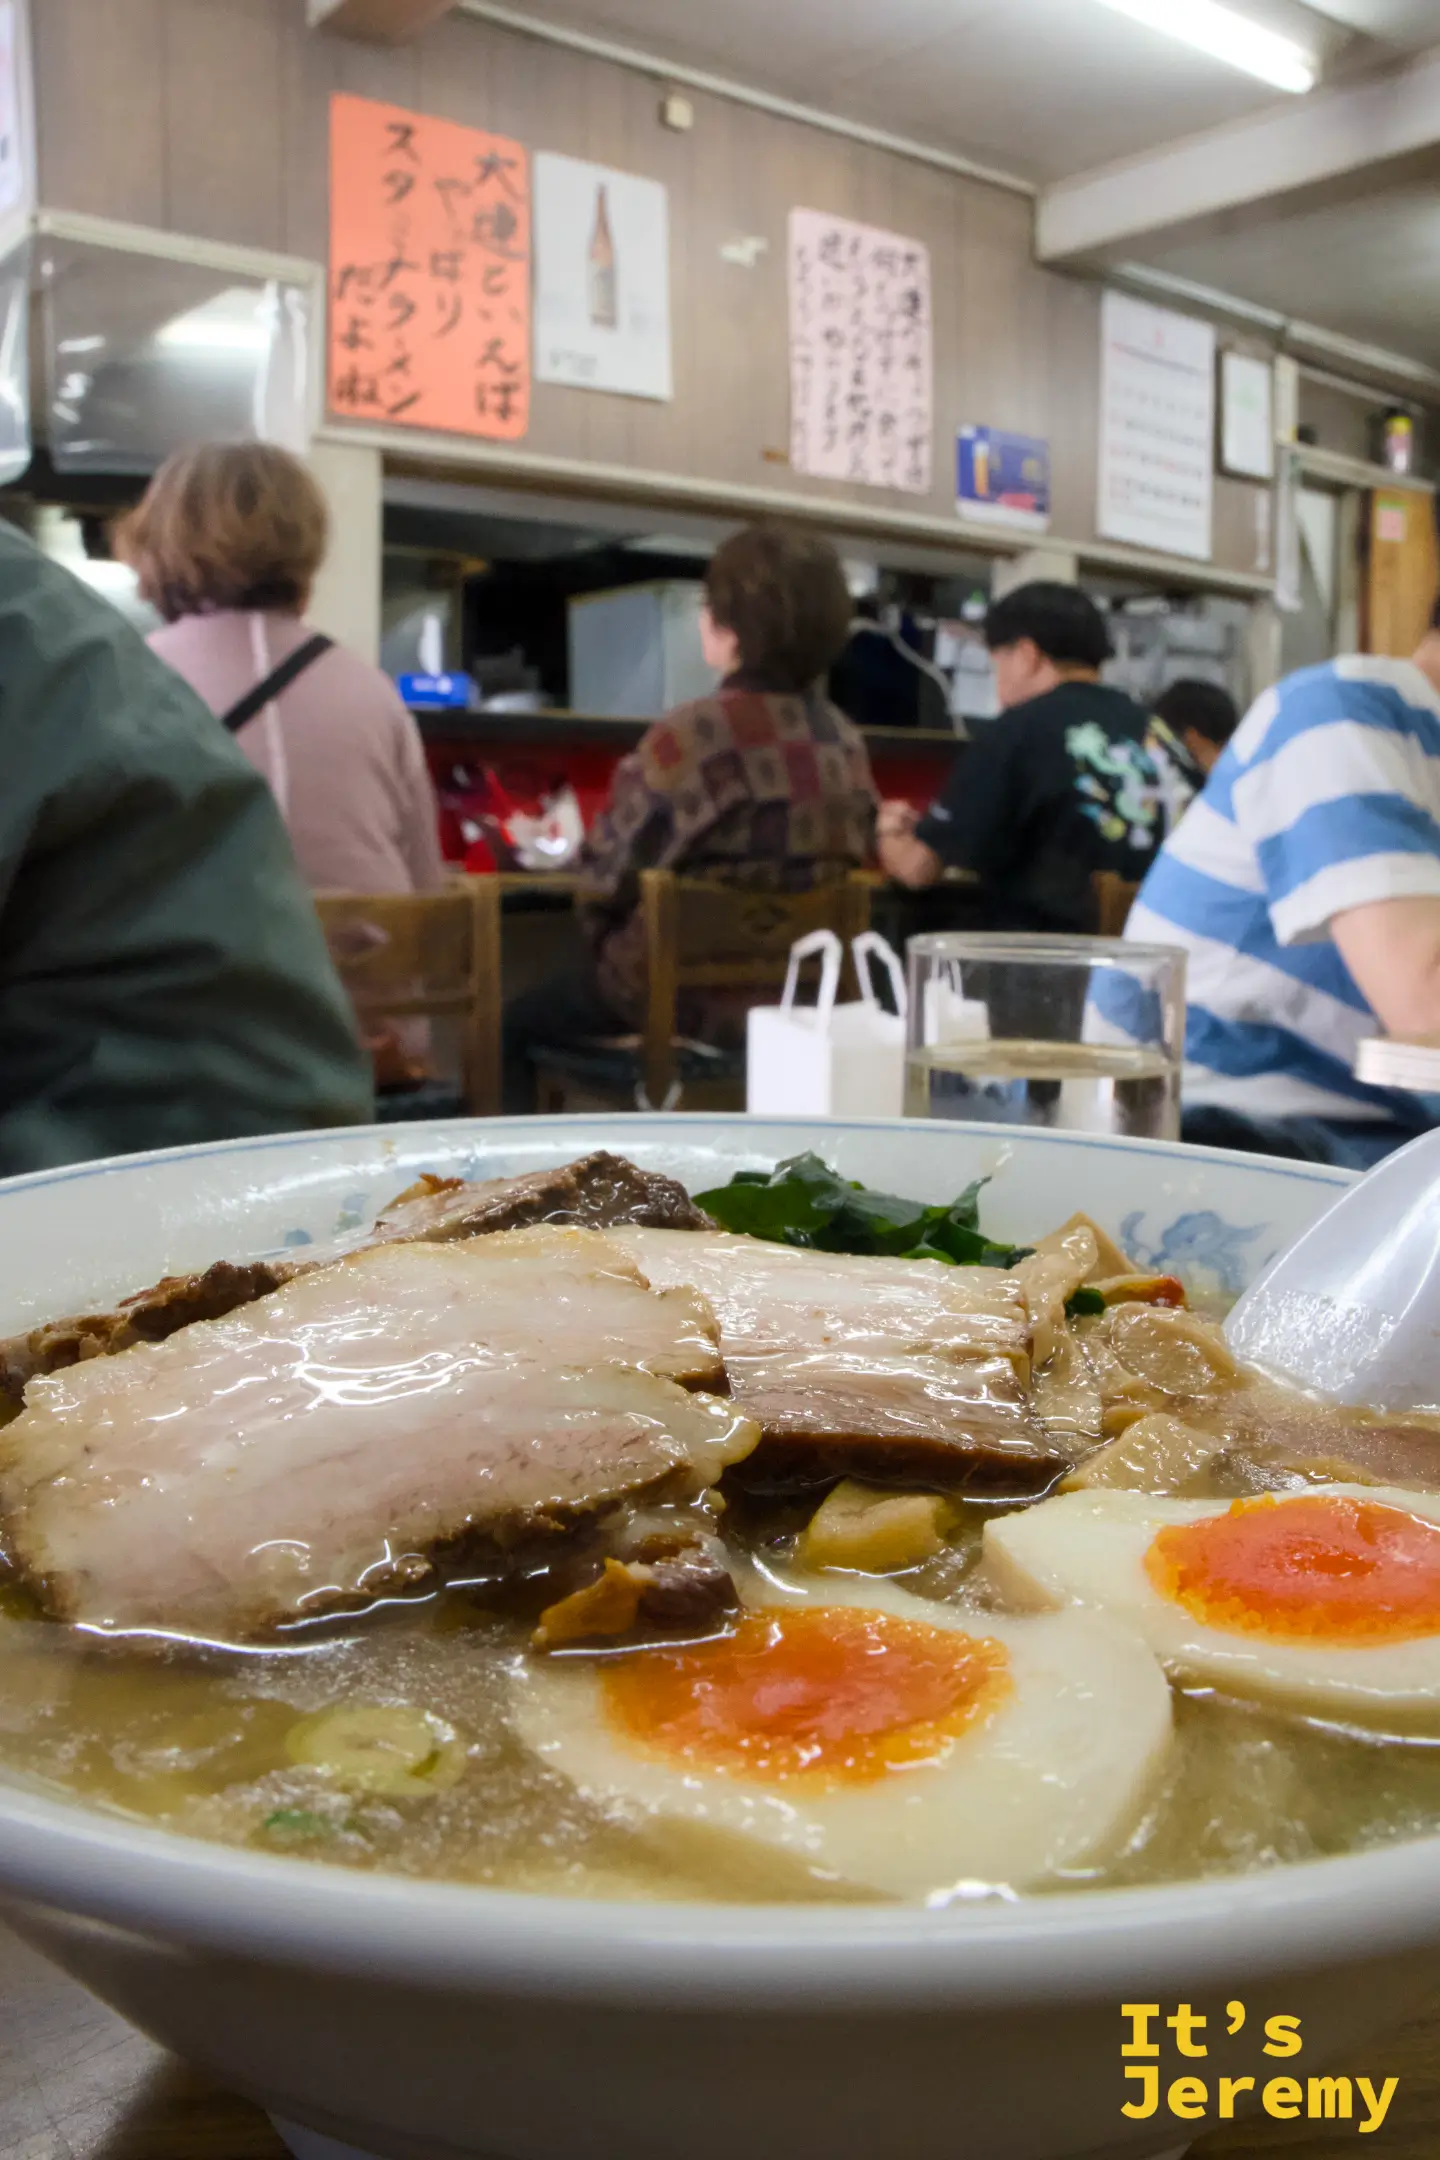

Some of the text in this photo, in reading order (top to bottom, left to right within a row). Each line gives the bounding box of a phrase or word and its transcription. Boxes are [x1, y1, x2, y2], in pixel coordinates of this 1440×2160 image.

[378, 121, 421, 415] スタナラーメン
